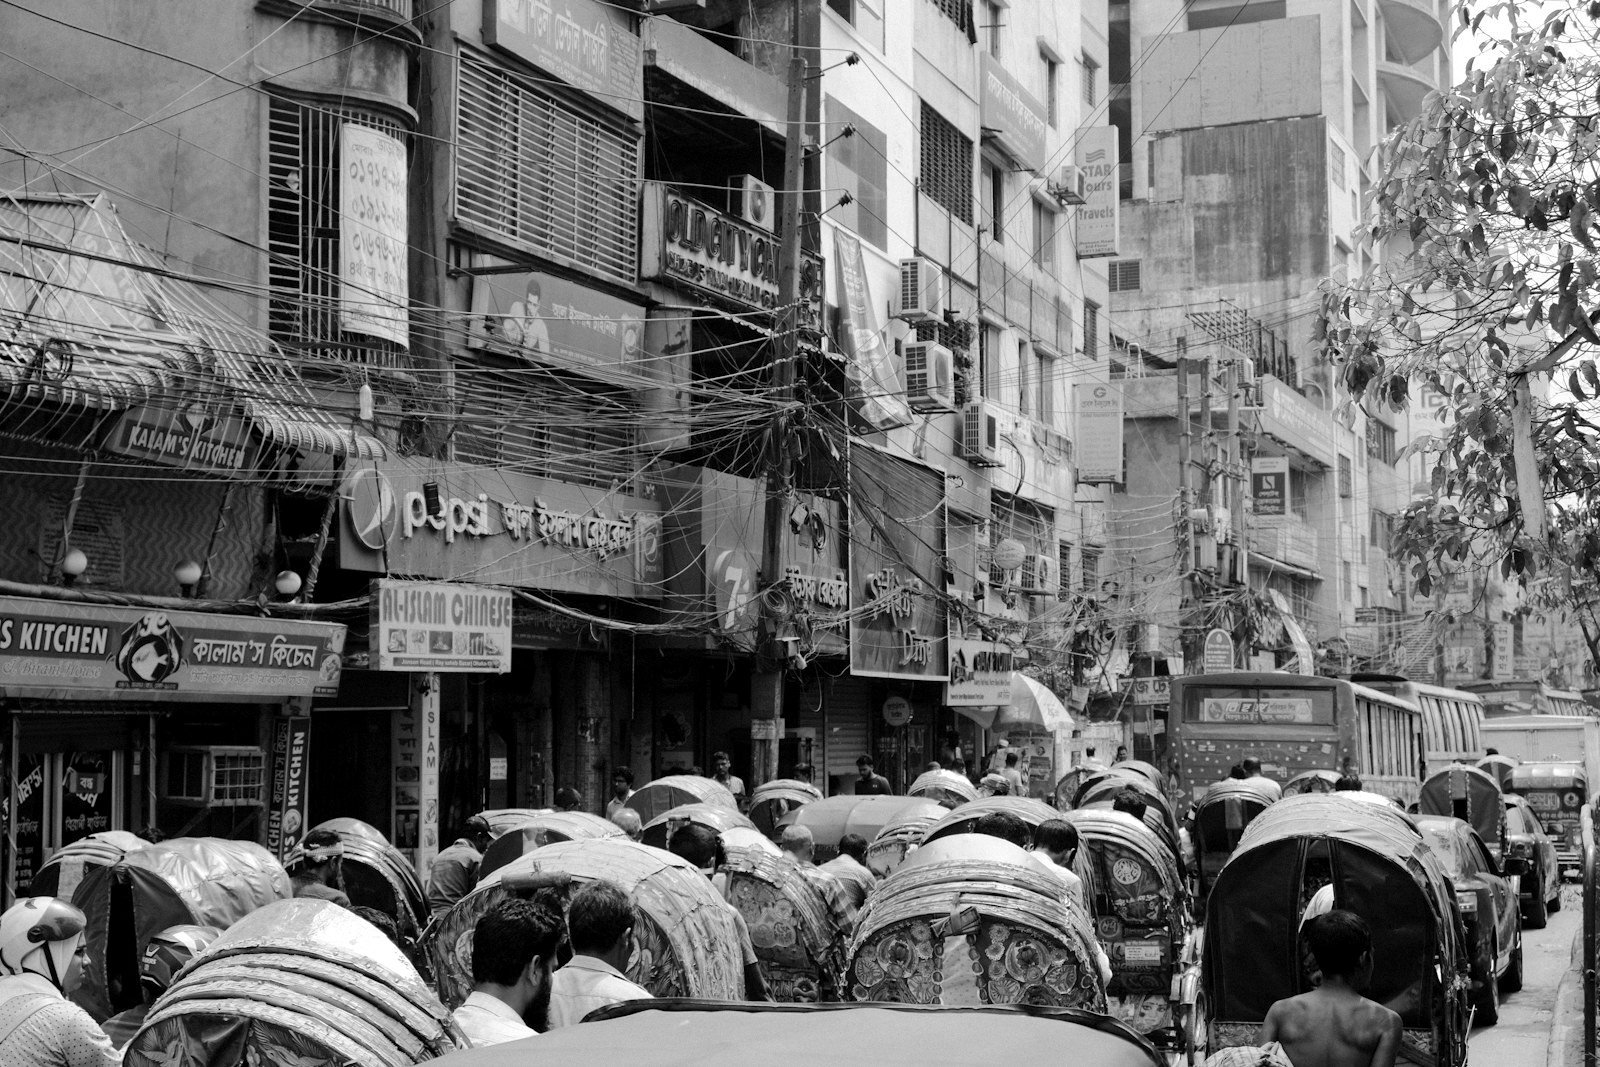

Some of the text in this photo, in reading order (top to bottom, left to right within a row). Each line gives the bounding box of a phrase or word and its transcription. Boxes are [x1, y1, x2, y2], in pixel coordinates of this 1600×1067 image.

[1082, 163, 1112, 177] STAR
[1084, 180, 1112, 192] ours
[1079, 206, 1115, 220] Travels
[128, 425, 246, 470] KALAM'S KITCHEN
[402, 492, 489, 544] pepsi
[382, 588, 511, 628] AL-ISLAM CHINESE
[19, 621, 108, 655] KITCHEN
[268, 634, 318, 668] কিচেন
[426, 697, 436, 769] ISLAM
[288, 732, 305, 807] KITCHEN
